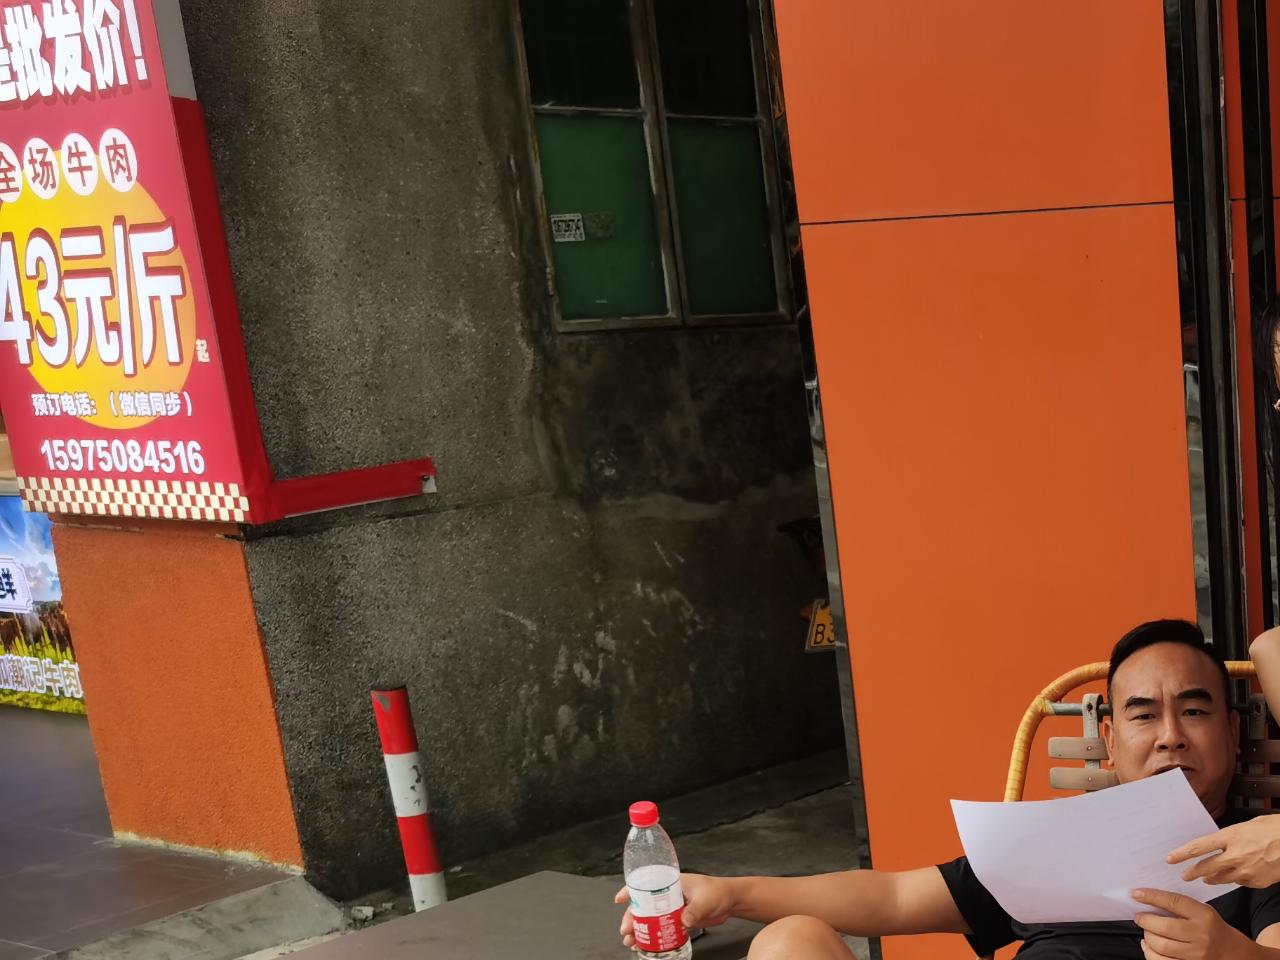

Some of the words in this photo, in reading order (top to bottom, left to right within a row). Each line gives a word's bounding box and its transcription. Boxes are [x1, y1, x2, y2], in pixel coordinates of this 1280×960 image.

[0, 136, 133, 195] 全场牛肉
[41, 438, 206, 475] 15975084516
